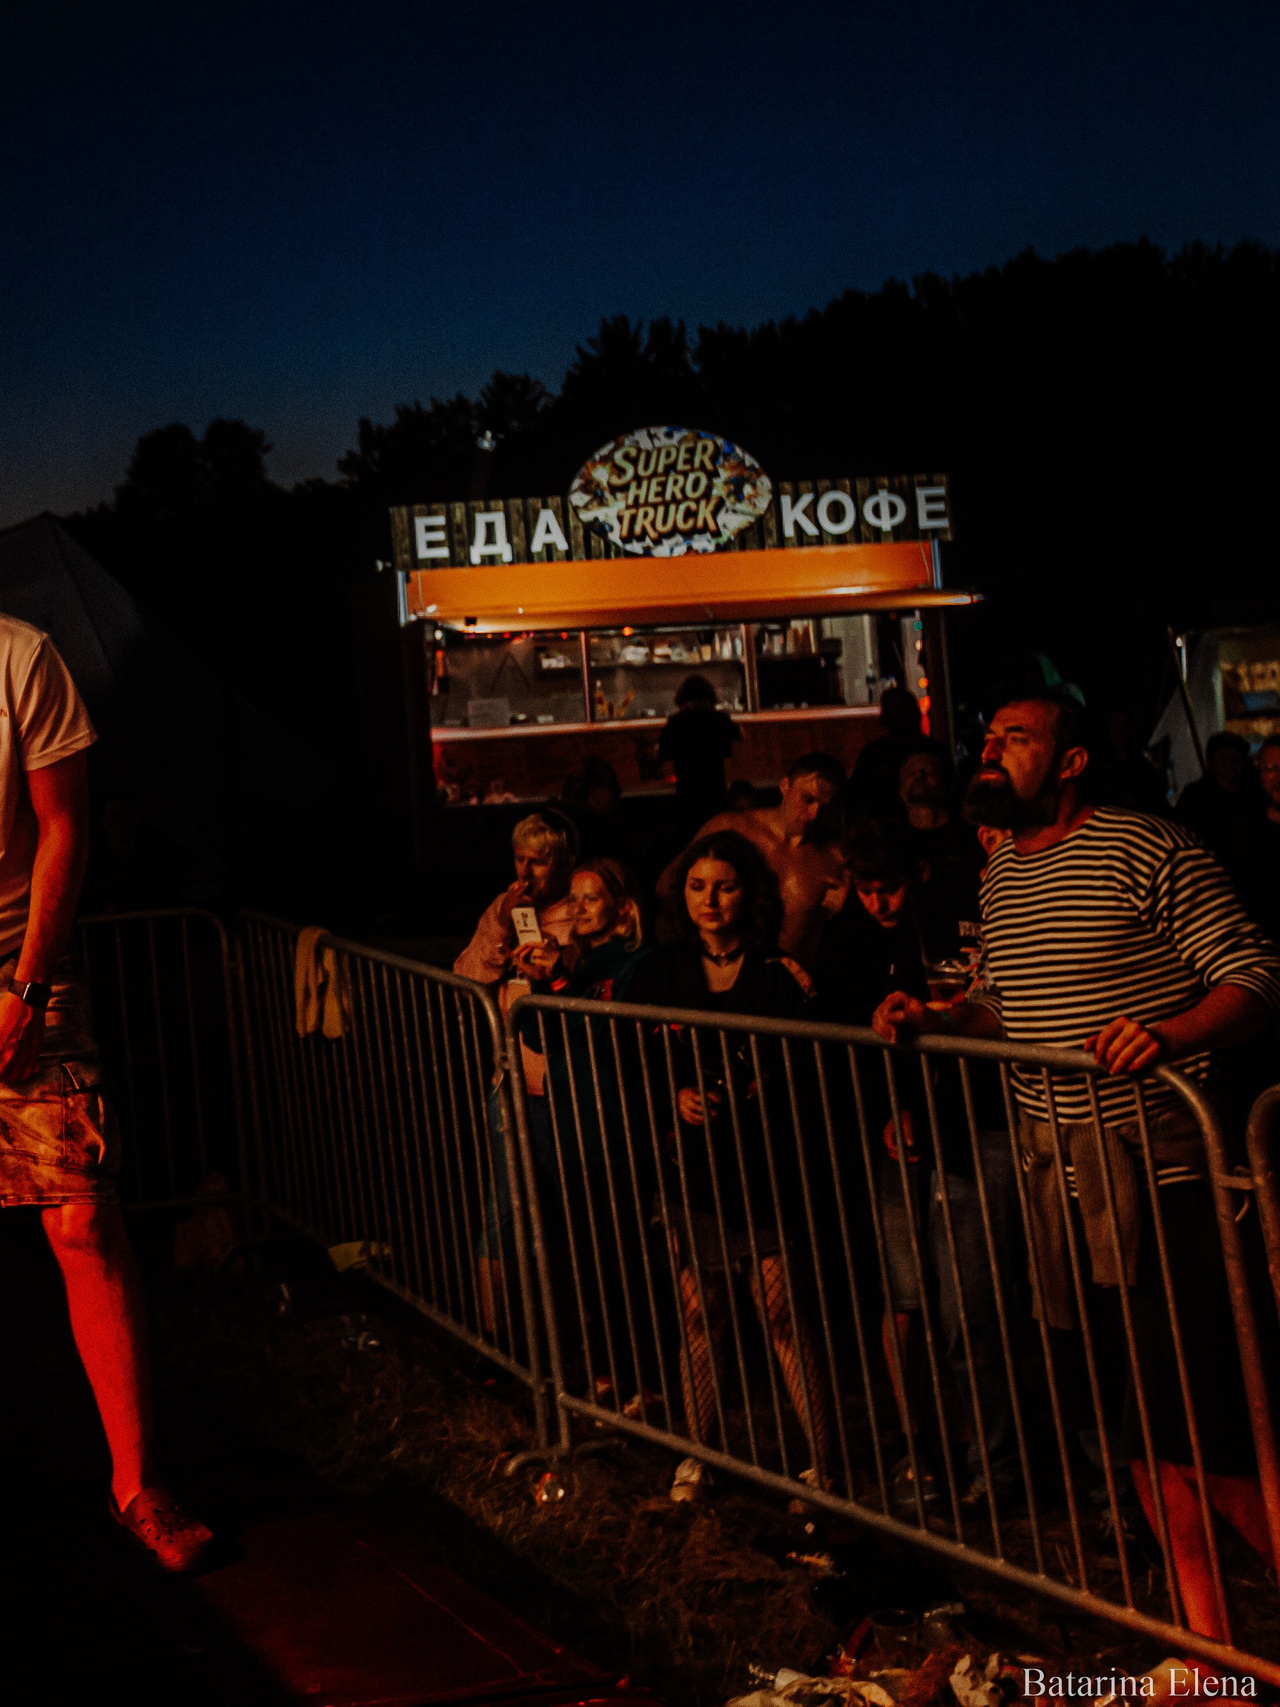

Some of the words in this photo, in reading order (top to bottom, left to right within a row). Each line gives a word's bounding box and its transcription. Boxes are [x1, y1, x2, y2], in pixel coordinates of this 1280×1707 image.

[608, 439, 715, 486] SUPER
[626, 471, 708, 506] HERO
[780, 486, 949, 538] КОФЕ
[414, 508, 569, 565] ЕДА
[618, 496, 720, 541] TRUCK
